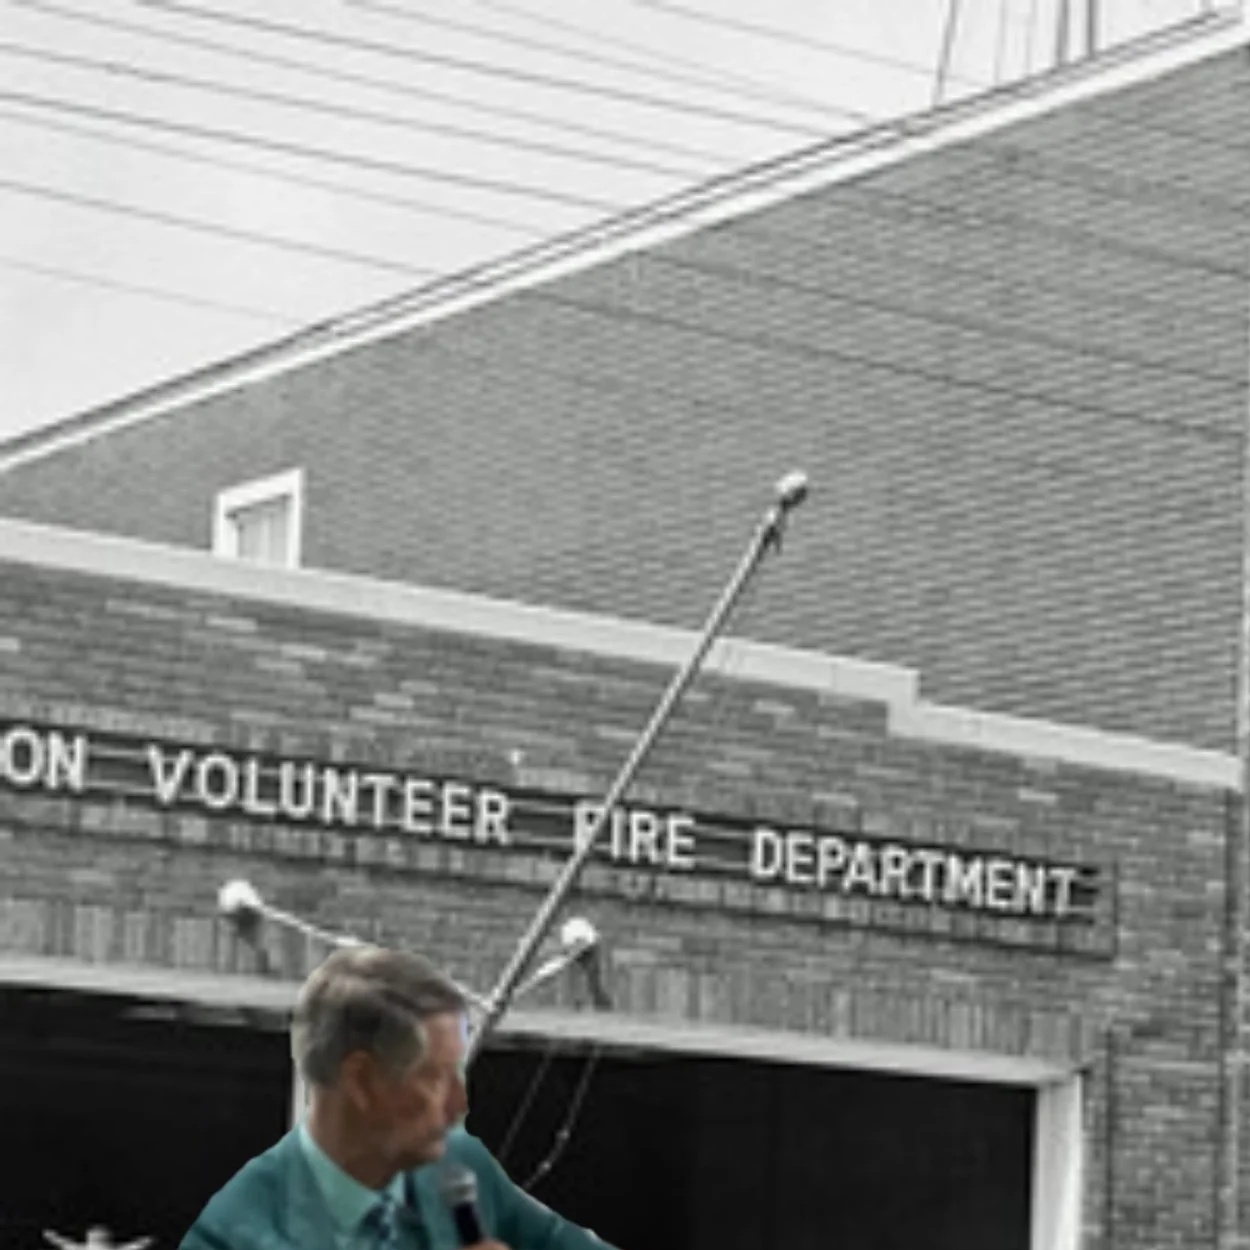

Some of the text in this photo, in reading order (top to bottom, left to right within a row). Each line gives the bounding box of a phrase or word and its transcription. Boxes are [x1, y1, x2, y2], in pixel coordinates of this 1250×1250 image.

[148, 745, 509, 844] VOLUNTEER
[573, 803, 696, 869] FIRE
[749, 829, 1077, 915] DEPARTMENT
